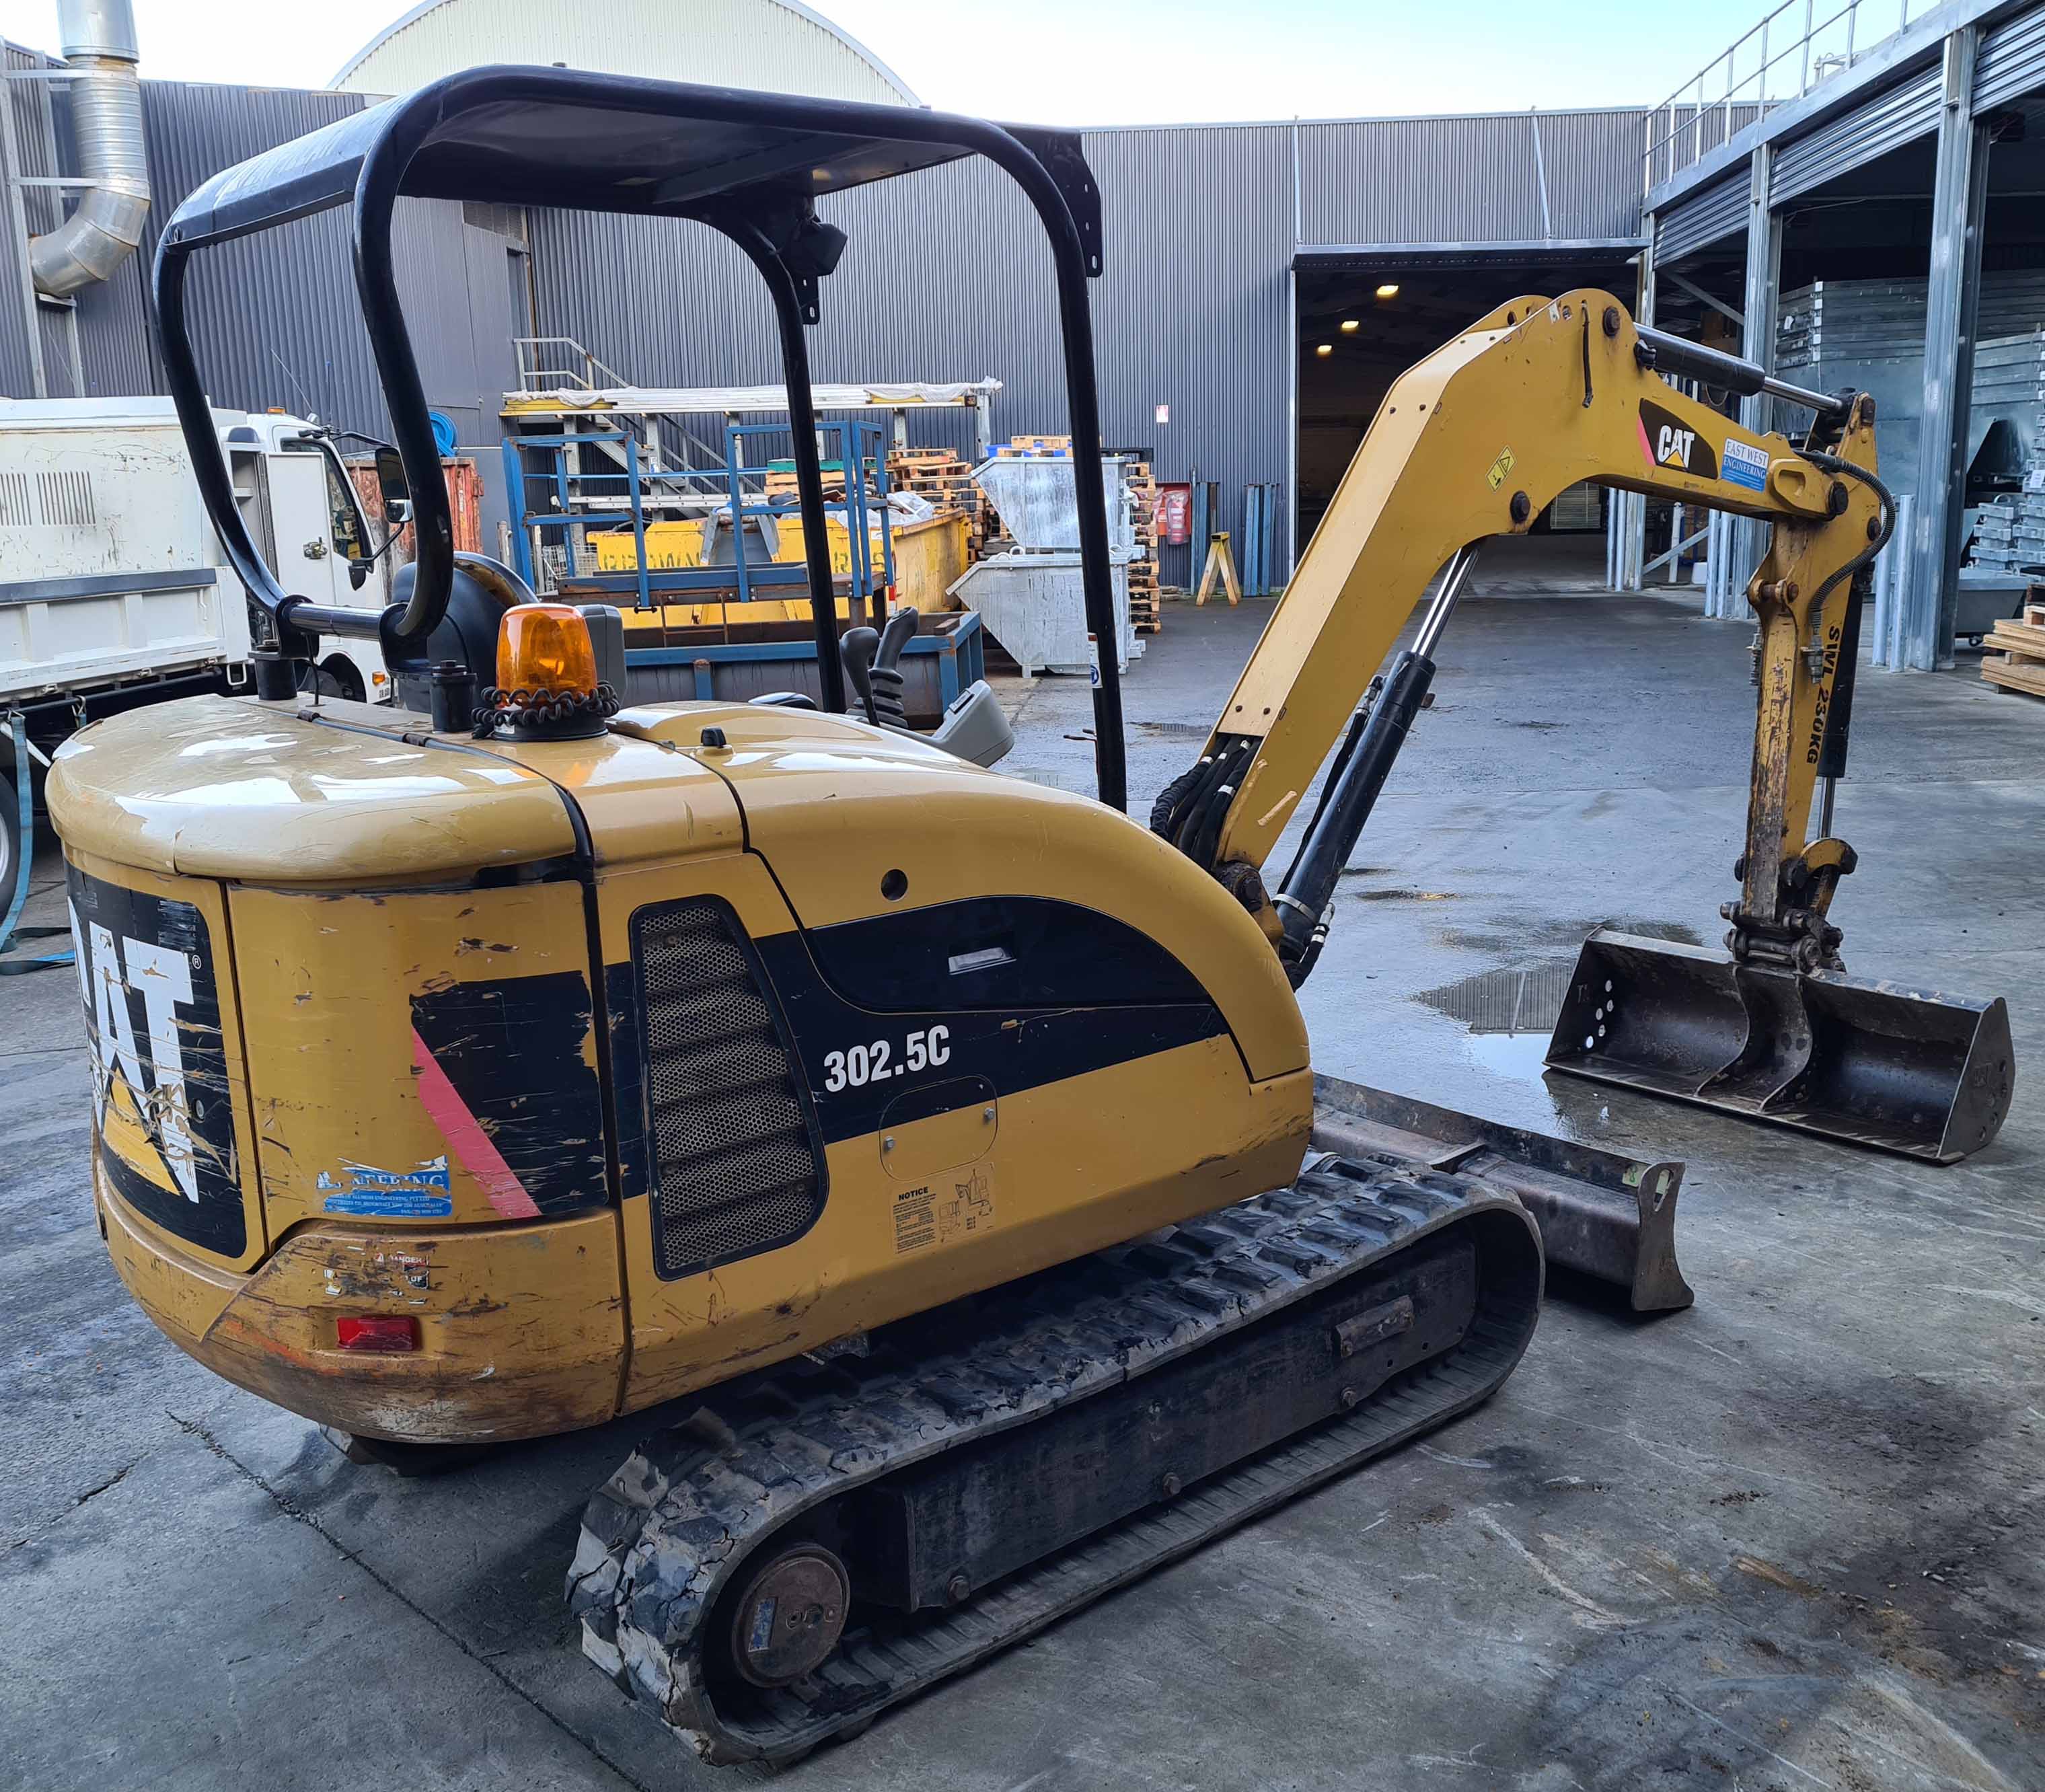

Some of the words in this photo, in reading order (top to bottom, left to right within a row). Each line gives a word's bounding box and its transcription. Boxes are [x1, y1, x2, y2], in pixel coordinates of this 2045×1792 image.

[1658, 425, 1695, 469] CAT
[1726, 441, 1746, 459] EAST
[1748, 449, 1768, 466] WEST
[1723, 456, 1766, 480] ENGINEERING
[1822, 626, 1840, 678] SWL
[67, 897, 200, 1203] AT
[824, 1024, 951, 1092] 302.5C
[898, 1186, 929, 1201] NOTICE
[389, 1254, 422, 1263] ANGER
